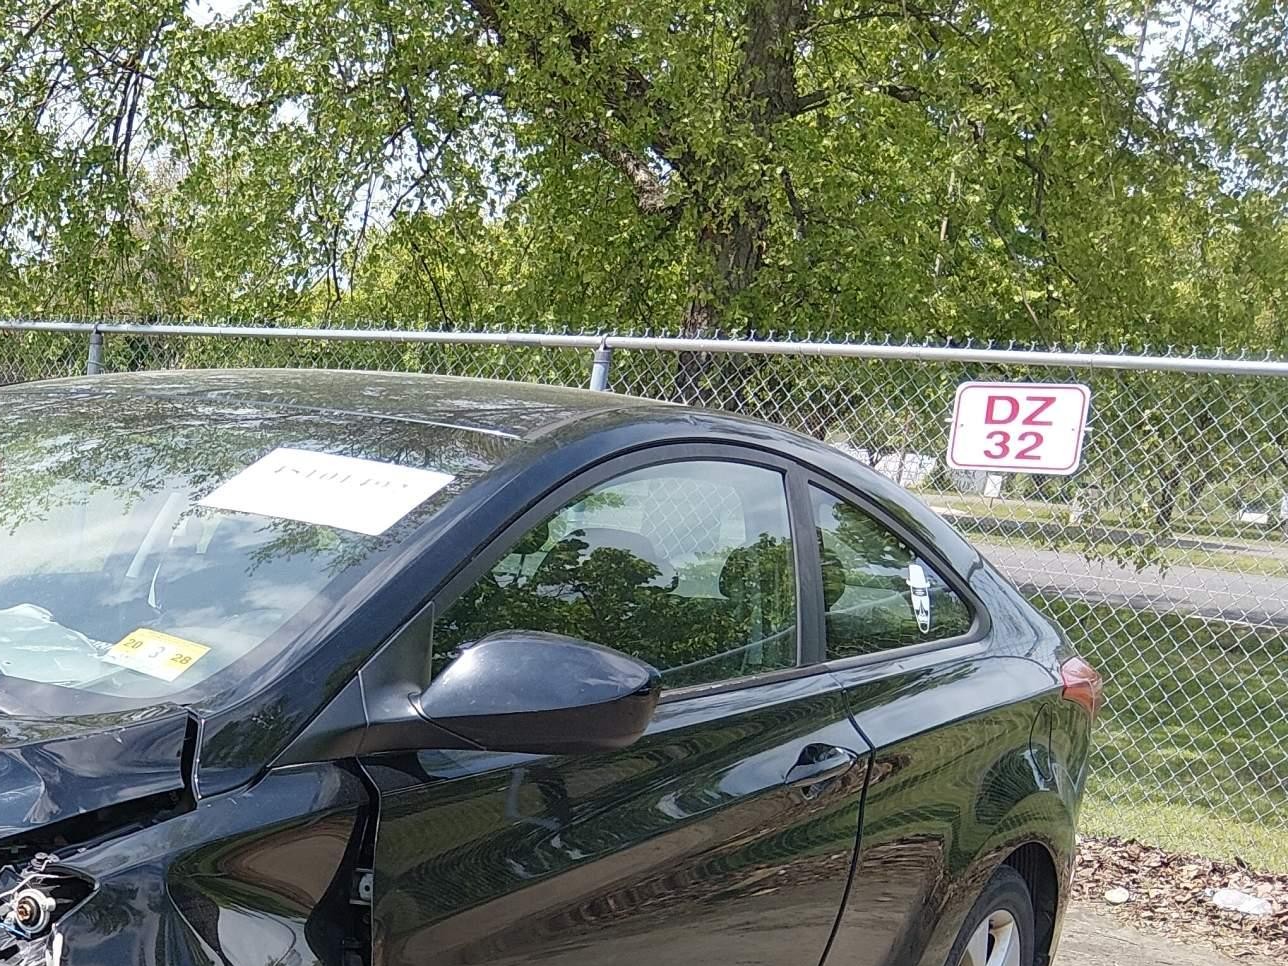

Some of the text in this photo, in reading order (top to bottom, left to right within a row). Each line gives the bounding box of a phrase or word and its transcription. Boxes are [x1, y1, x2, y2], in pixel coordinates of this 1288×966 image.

[984, 395, 1057, 426] DZ
[983, 430, 1044, 460] 32
[123, 638, 143, 649] 20
[170, 653, 192, 665] 28
